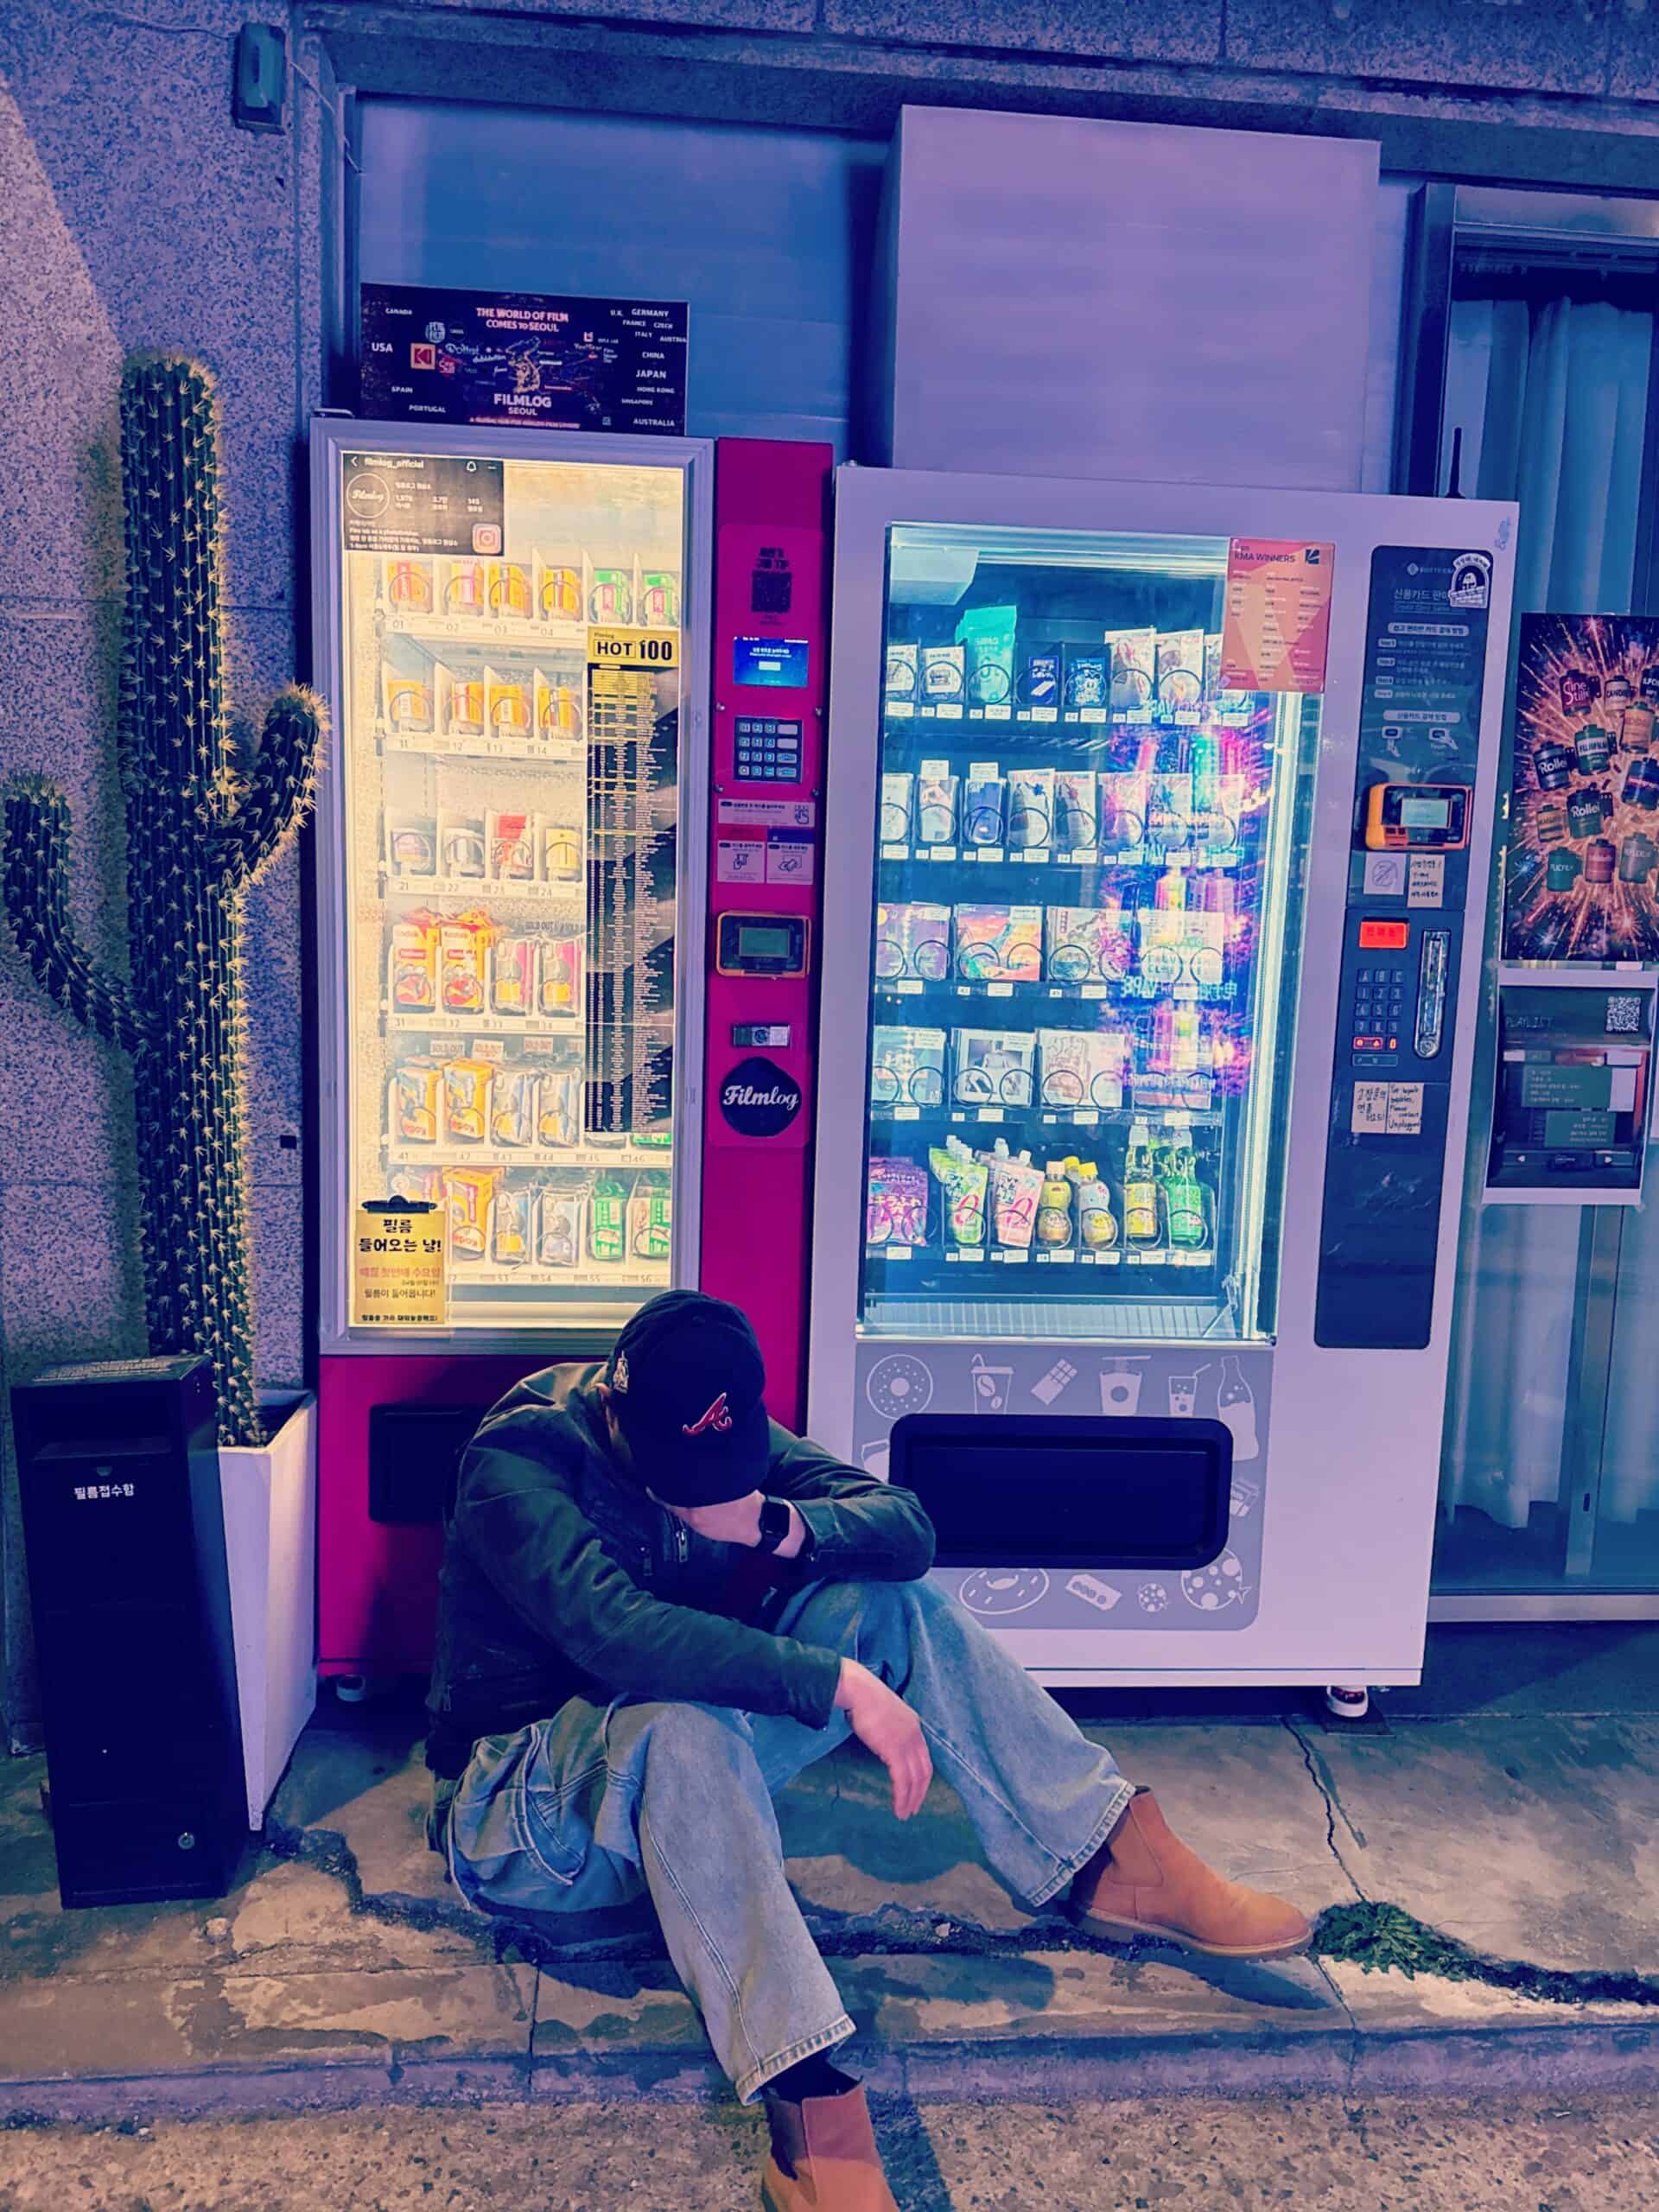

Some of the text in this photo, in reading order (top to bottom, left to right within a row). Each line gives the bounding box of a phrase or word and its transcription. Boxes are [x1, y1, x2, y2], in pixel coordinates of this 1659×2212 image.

[476, 308, 569, 322] THE WORLD OF FILM
[632, 308, 669, 317] GERMANY
[486, 319, 518, 329] COMES
[529, 322, 559, 332] SEOUL
[372, 342, 393, 353] USA
[636, 369, 666, 379] JAPAN
[493, 393, 552, 408] FILMLOG
[409, 404, 446, 413] PORTUGAL
[508, 407, 537, 416] SEOUL
[633, 418, 675, 427] AUSTRALIA
[1256, 554, 1295, 563] WINNERS
[597, 639, 672, 660] HOT 100
[1572, 802, 1600, 817] Rollei
[723, 1084, 799, 1110] Filmlog
[383, 1219, 413, 1234] 필름
[359, 1238, 442, 1253] 들어오는 날!
[413, 1267, 441, 1279] 수요일
[73, 1483, 135, 1500] 필름접수함
